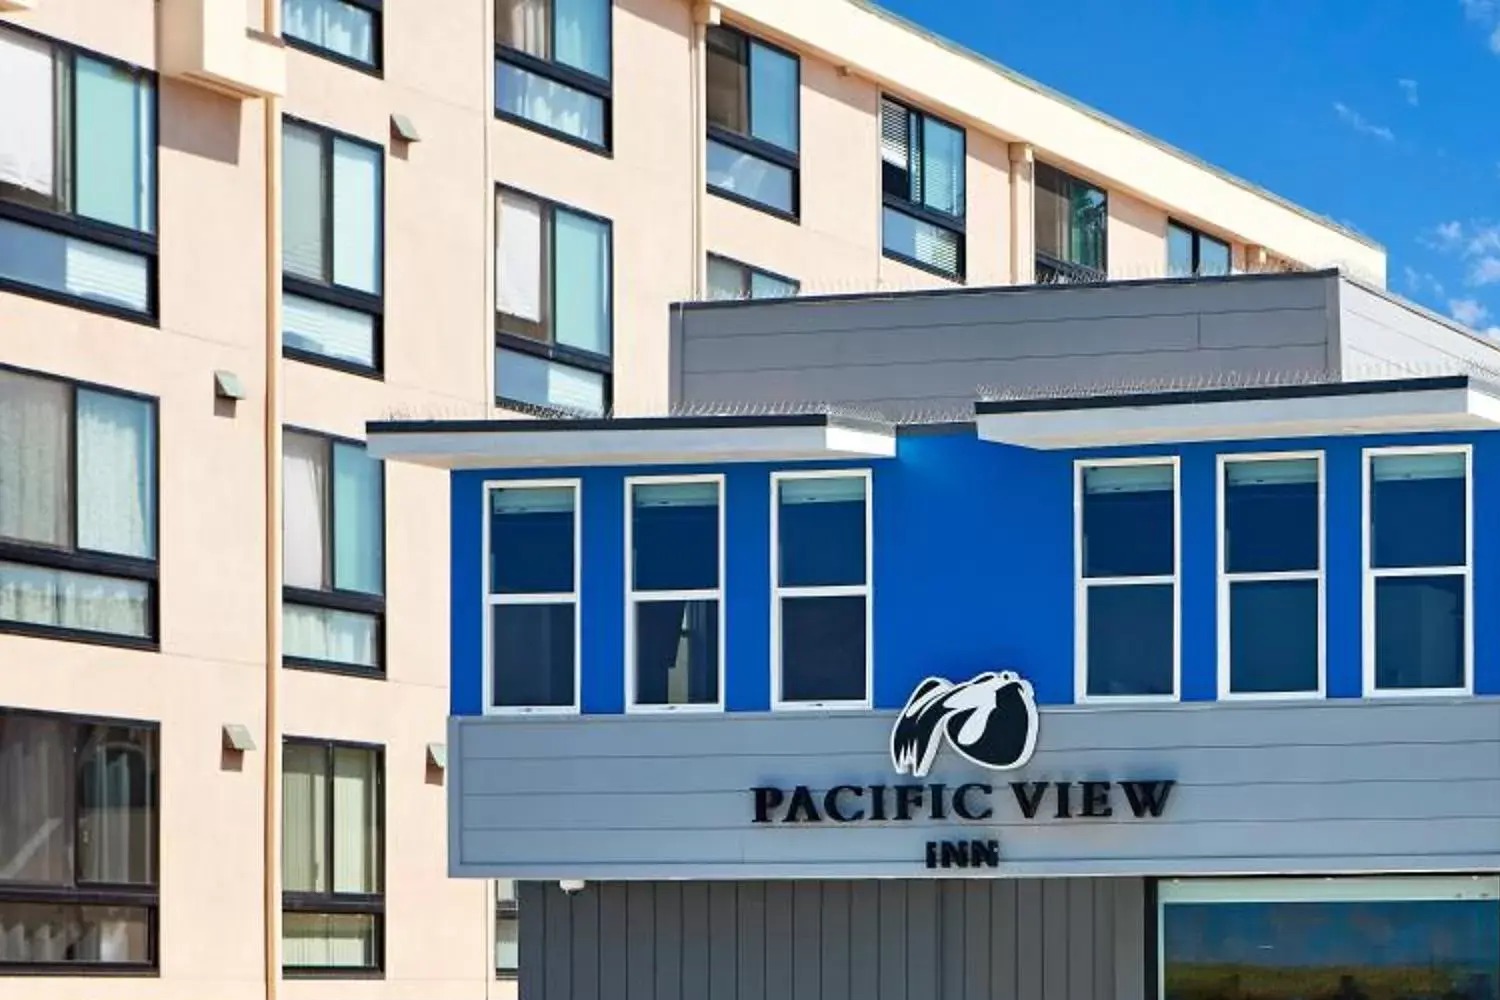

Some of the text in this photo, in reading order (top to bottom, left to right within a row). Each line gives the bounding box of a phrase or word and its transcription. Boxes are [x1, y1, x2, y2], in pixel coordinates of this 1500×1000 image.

[750, 780, 1177, 823] PACIFIC VIEW
[925, 840, 999, 869] INN
